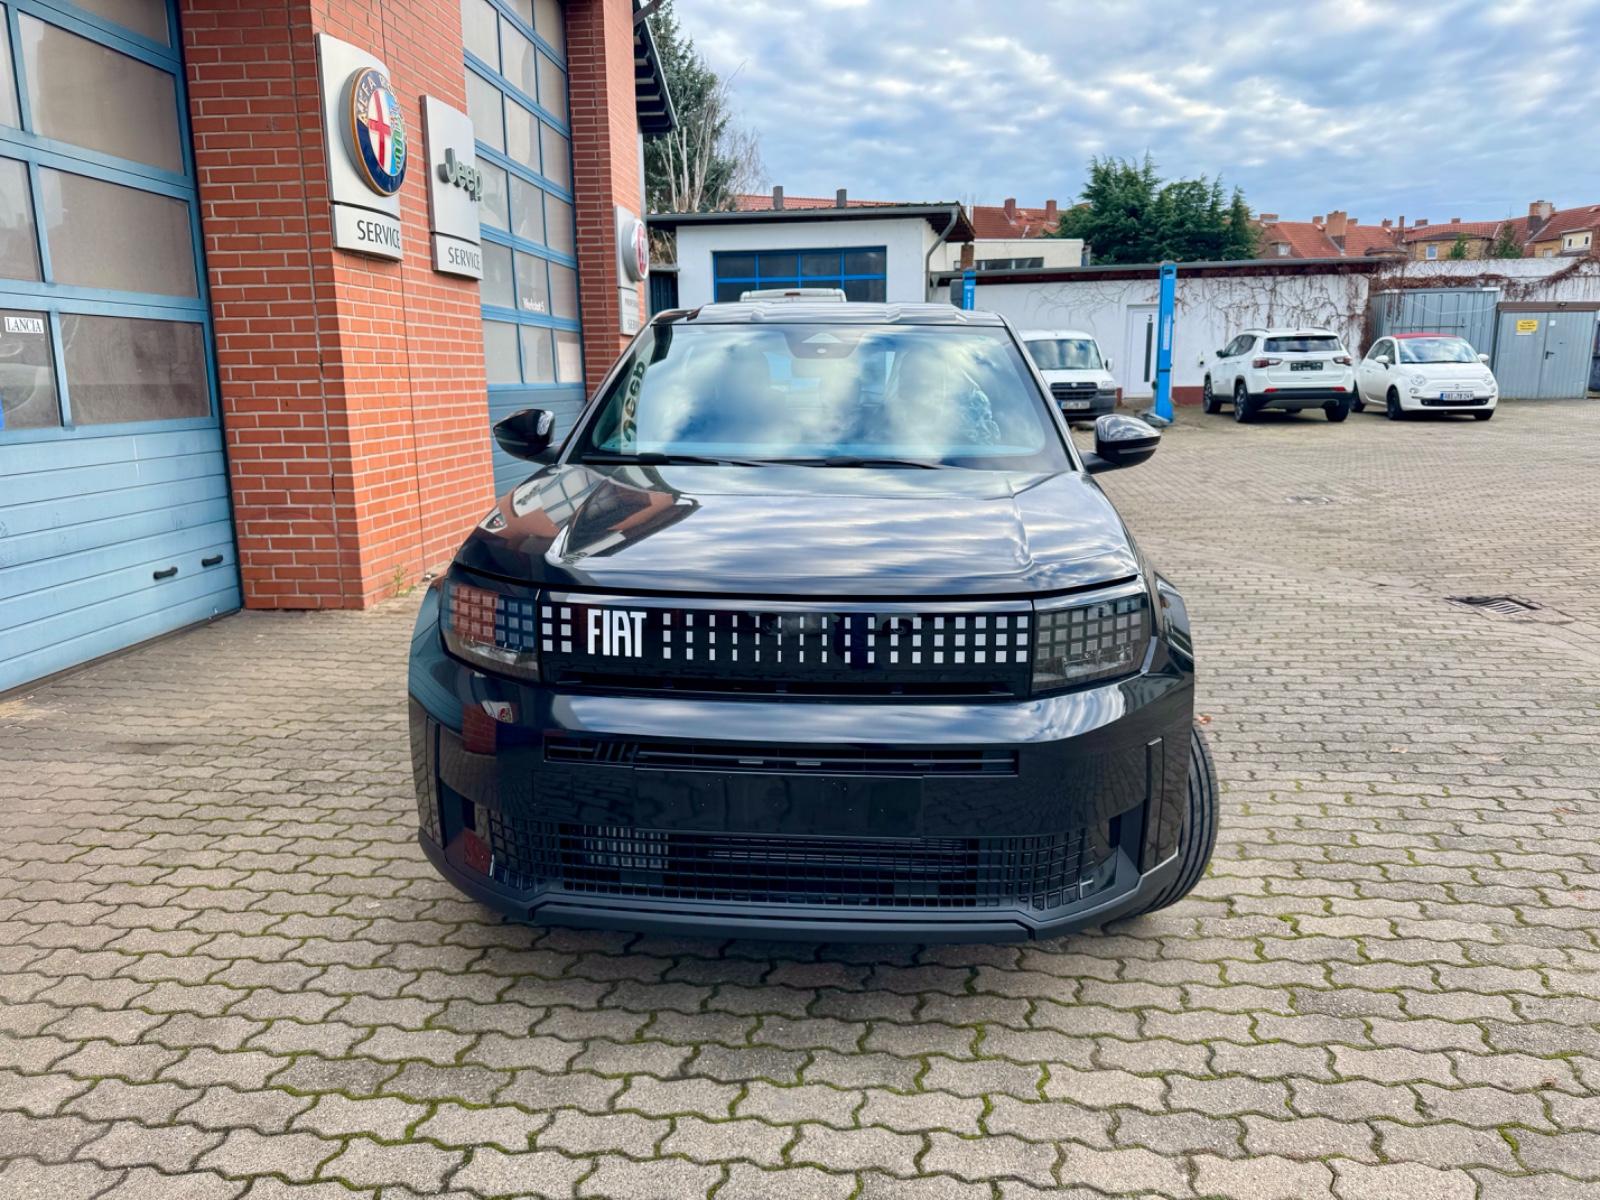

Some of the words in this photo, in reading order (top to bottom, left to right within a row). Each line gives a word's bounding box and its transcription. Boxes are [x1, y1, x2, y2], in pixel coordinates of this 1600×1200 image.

[439, 148, 483, 201] Jeep
[356, 220, 401, 250] SERVICE
[447, 246, 480, 270] SERVICE
[6, 317, 42, 332] LANCIA
[587, 608, 647, 658] FIAT
